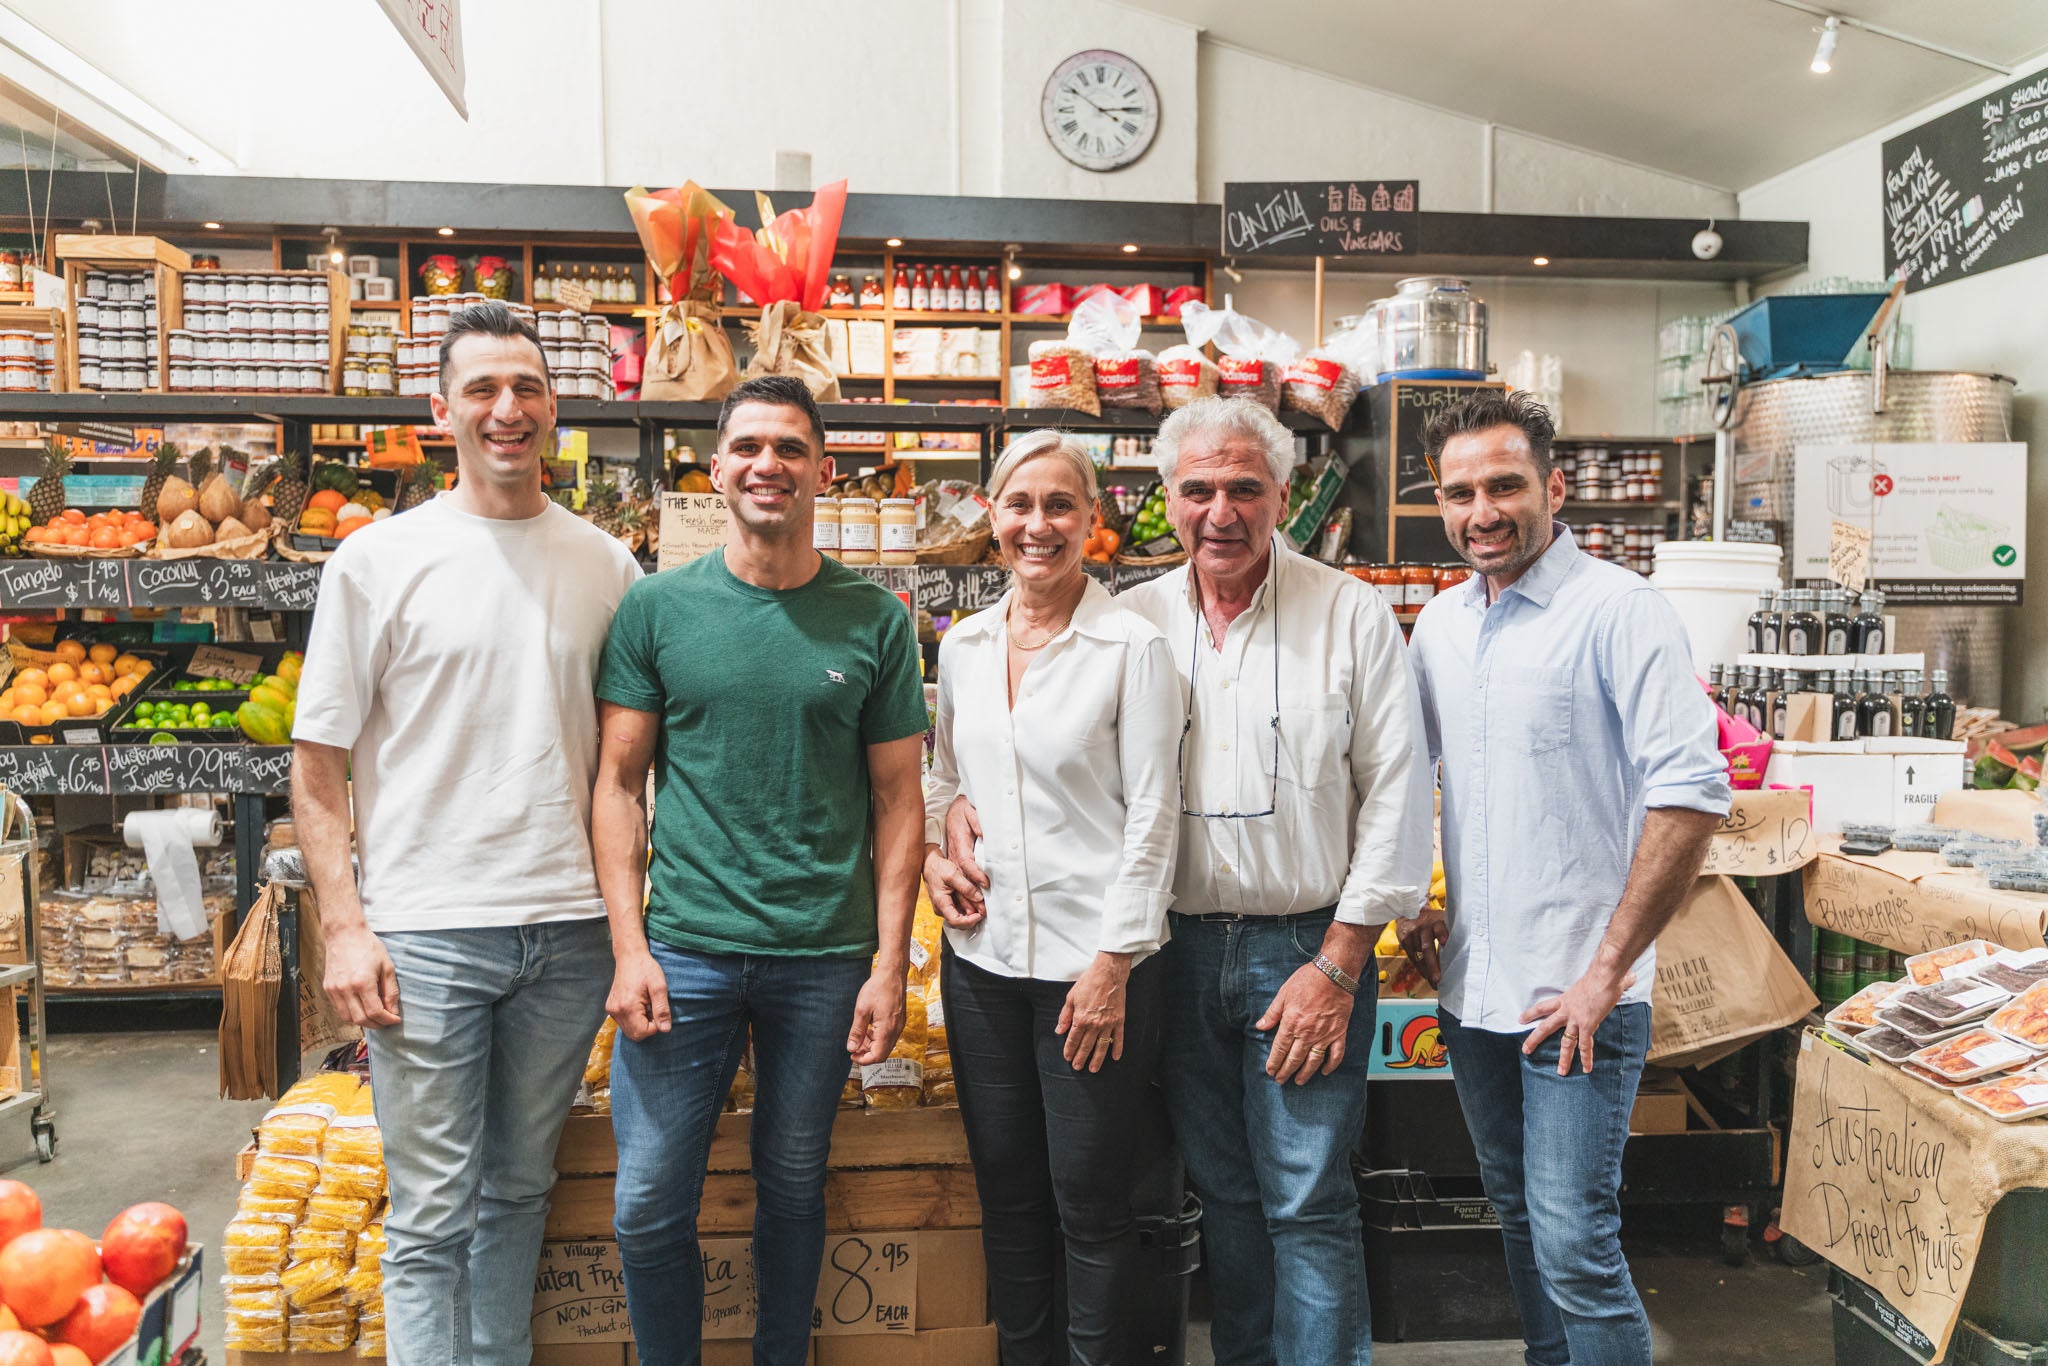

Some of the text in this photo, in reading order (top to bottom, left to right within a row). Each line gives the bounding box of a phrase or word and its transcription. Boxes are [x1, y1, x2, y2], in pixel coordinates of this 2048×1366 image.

[1982, 99, 2003, 120] NOW
[1886, 144, 1924, 199] FOURTH
[1885, 158, 1941, 228] VILLAGE
[1228, 189, 1314, 249] CANTINA
[1320, 217, 1348, 232] OILS
[1891, 179, 1960, 260] ESTATE
[1929, 208, 1963, 257] 1997
[1339, 231, 1403, 252] VINEGARS
[664, 496, 688, 510] THE
[694, 497, 713, 510] NUT
[0, 559, 63, 597] Tangelo
[138, 560, 201, 589] Coconut
[109, 746, 182, 771] Australian
[122, 765, 175, 792] Limes
[1904, 793, 1938, 804] FRAGILE
[1815, 887, 1914, 946] Blueberries
[1658, 955, 1709, 983] FOURTH
[1663, 974, 1716, 1001] VILLAGE
[1812, 1056, 1949, 1206] Australian
[1808, 1182, 1964, 1297] Dried Fruits
[563, 1245, 608, 1262] Village
[875, 1304, 909, 1322] EACH
[576, 1317, 617, 1337] Product
